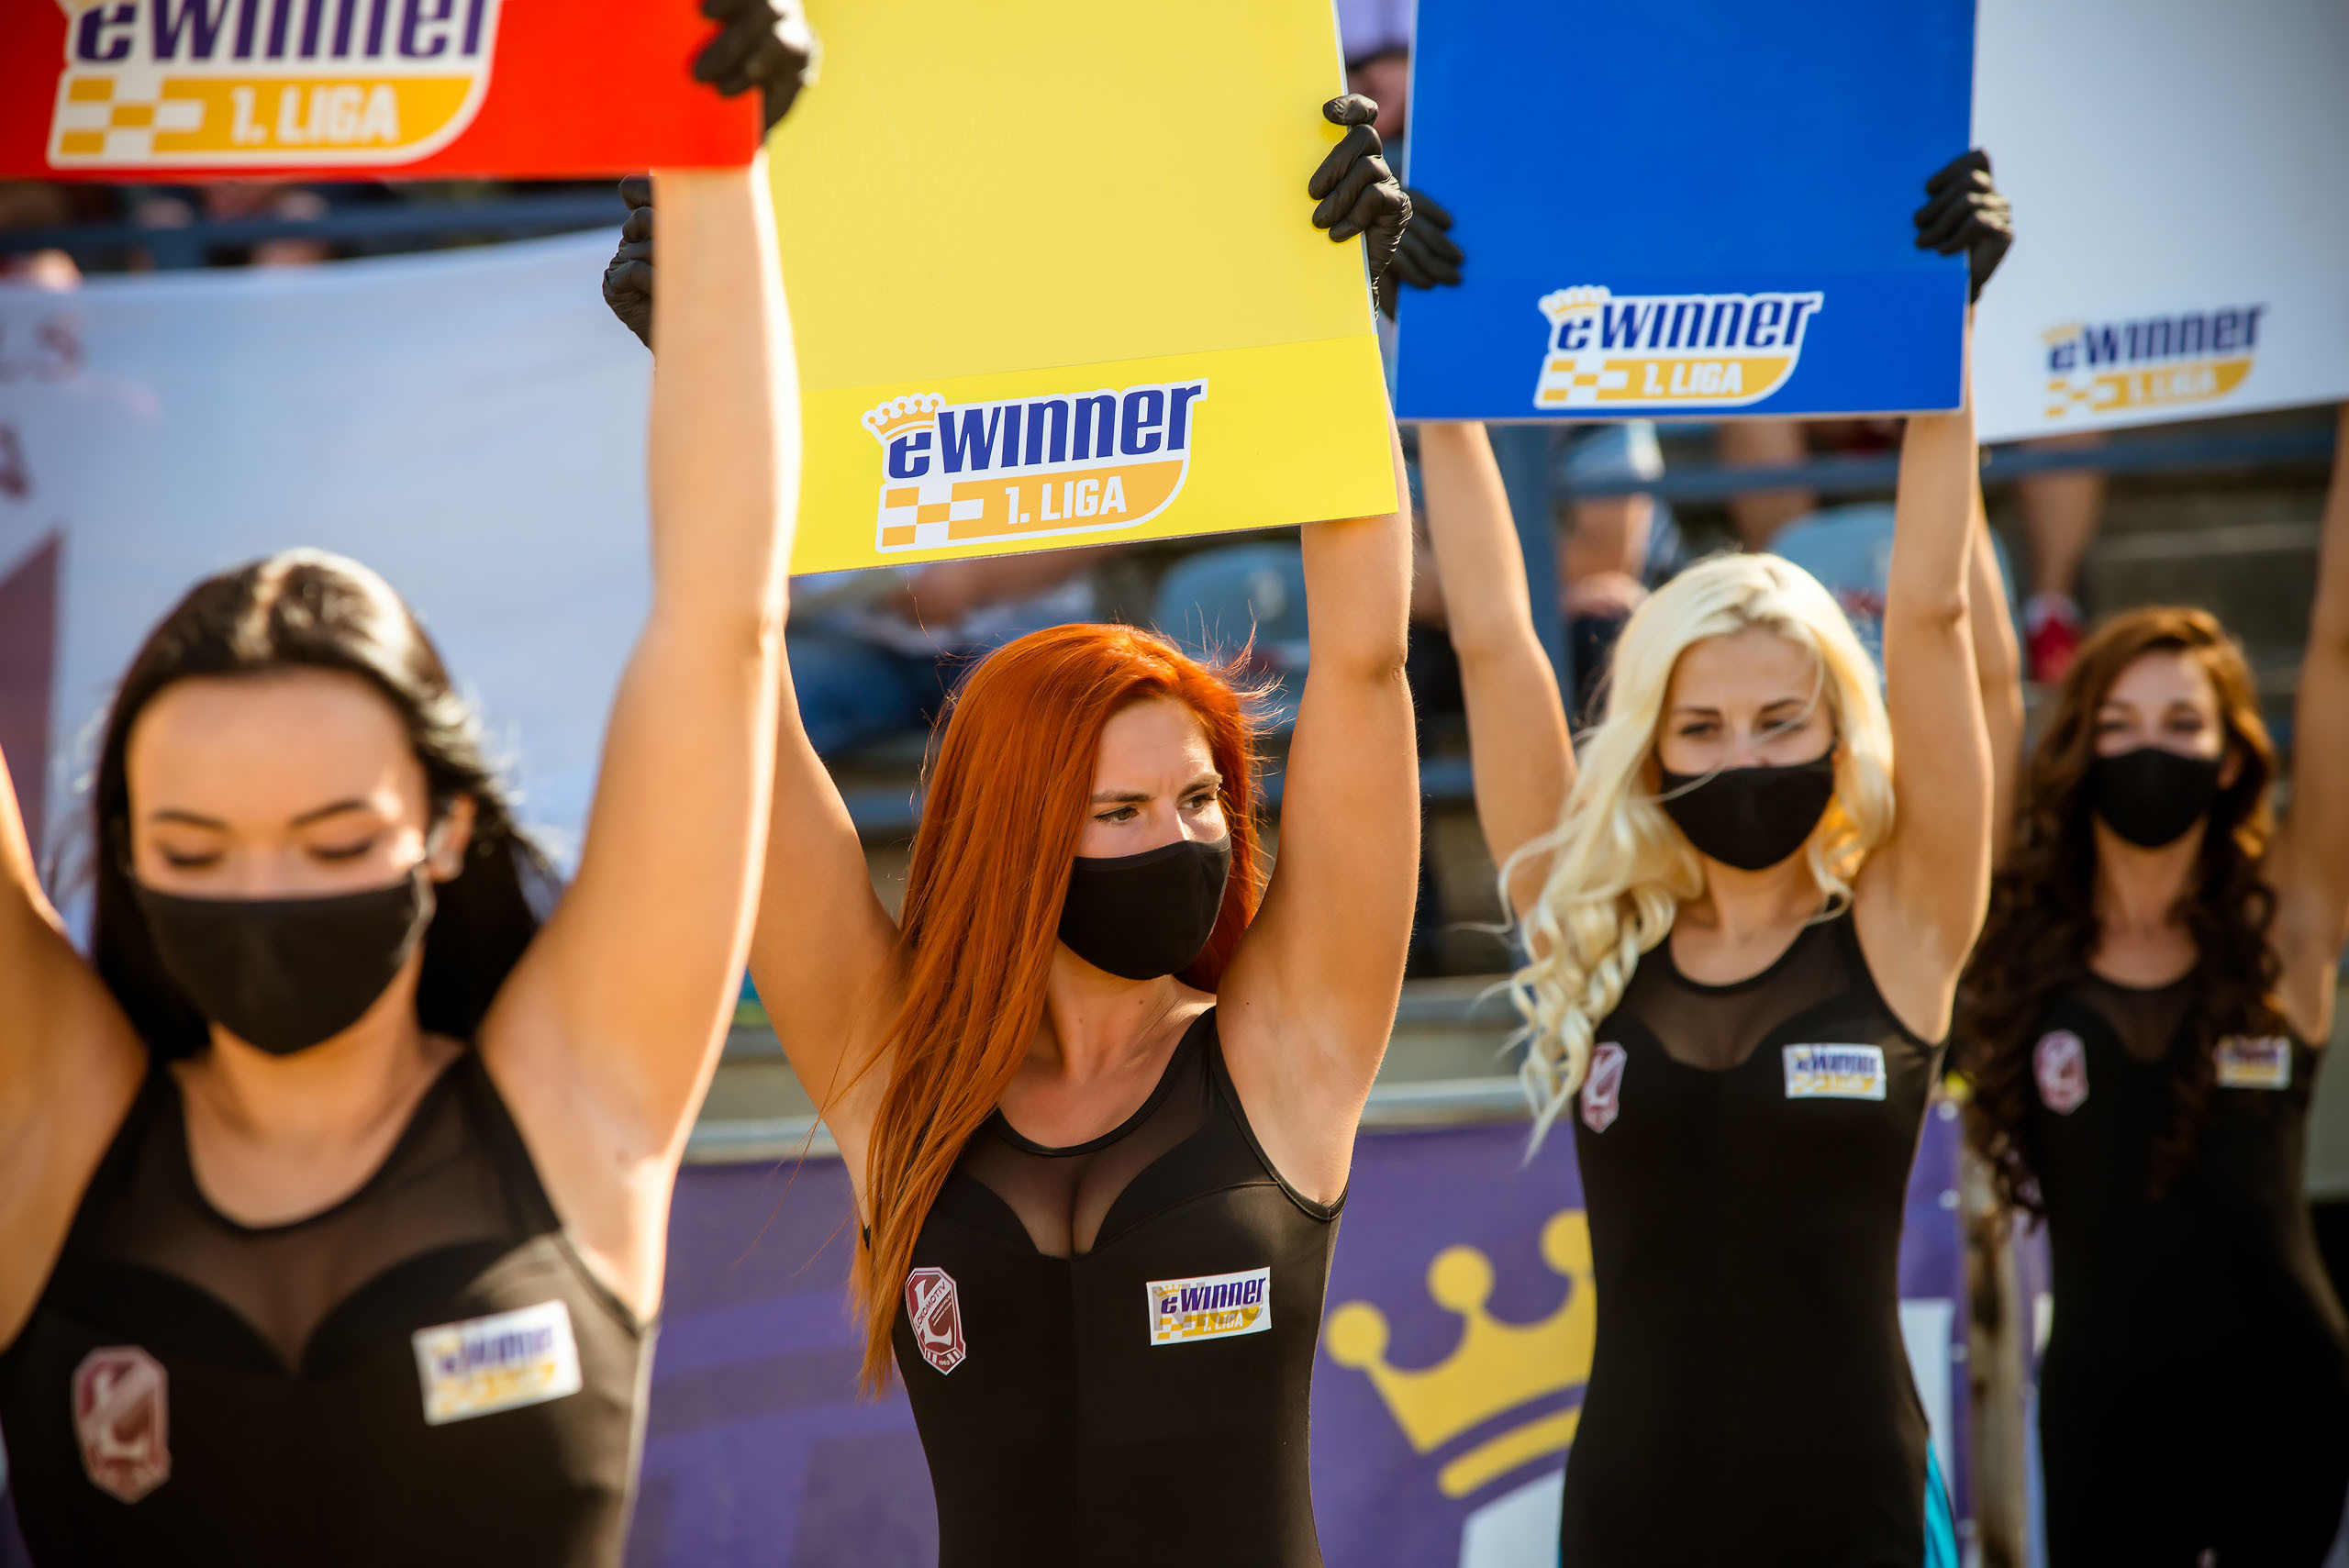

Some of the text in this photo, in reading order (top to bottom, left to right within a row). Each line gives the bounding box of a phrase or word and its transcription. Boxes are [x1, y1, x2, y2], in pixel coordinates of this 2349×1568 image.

[229, 84, 398, 144] 1. LIGA
[1642, 361, 1742, 395] 1. LIGA
[1005, 475, 1127, 525] 1. LIGA
[1215, 1312, 1243, 1330] LIGA
